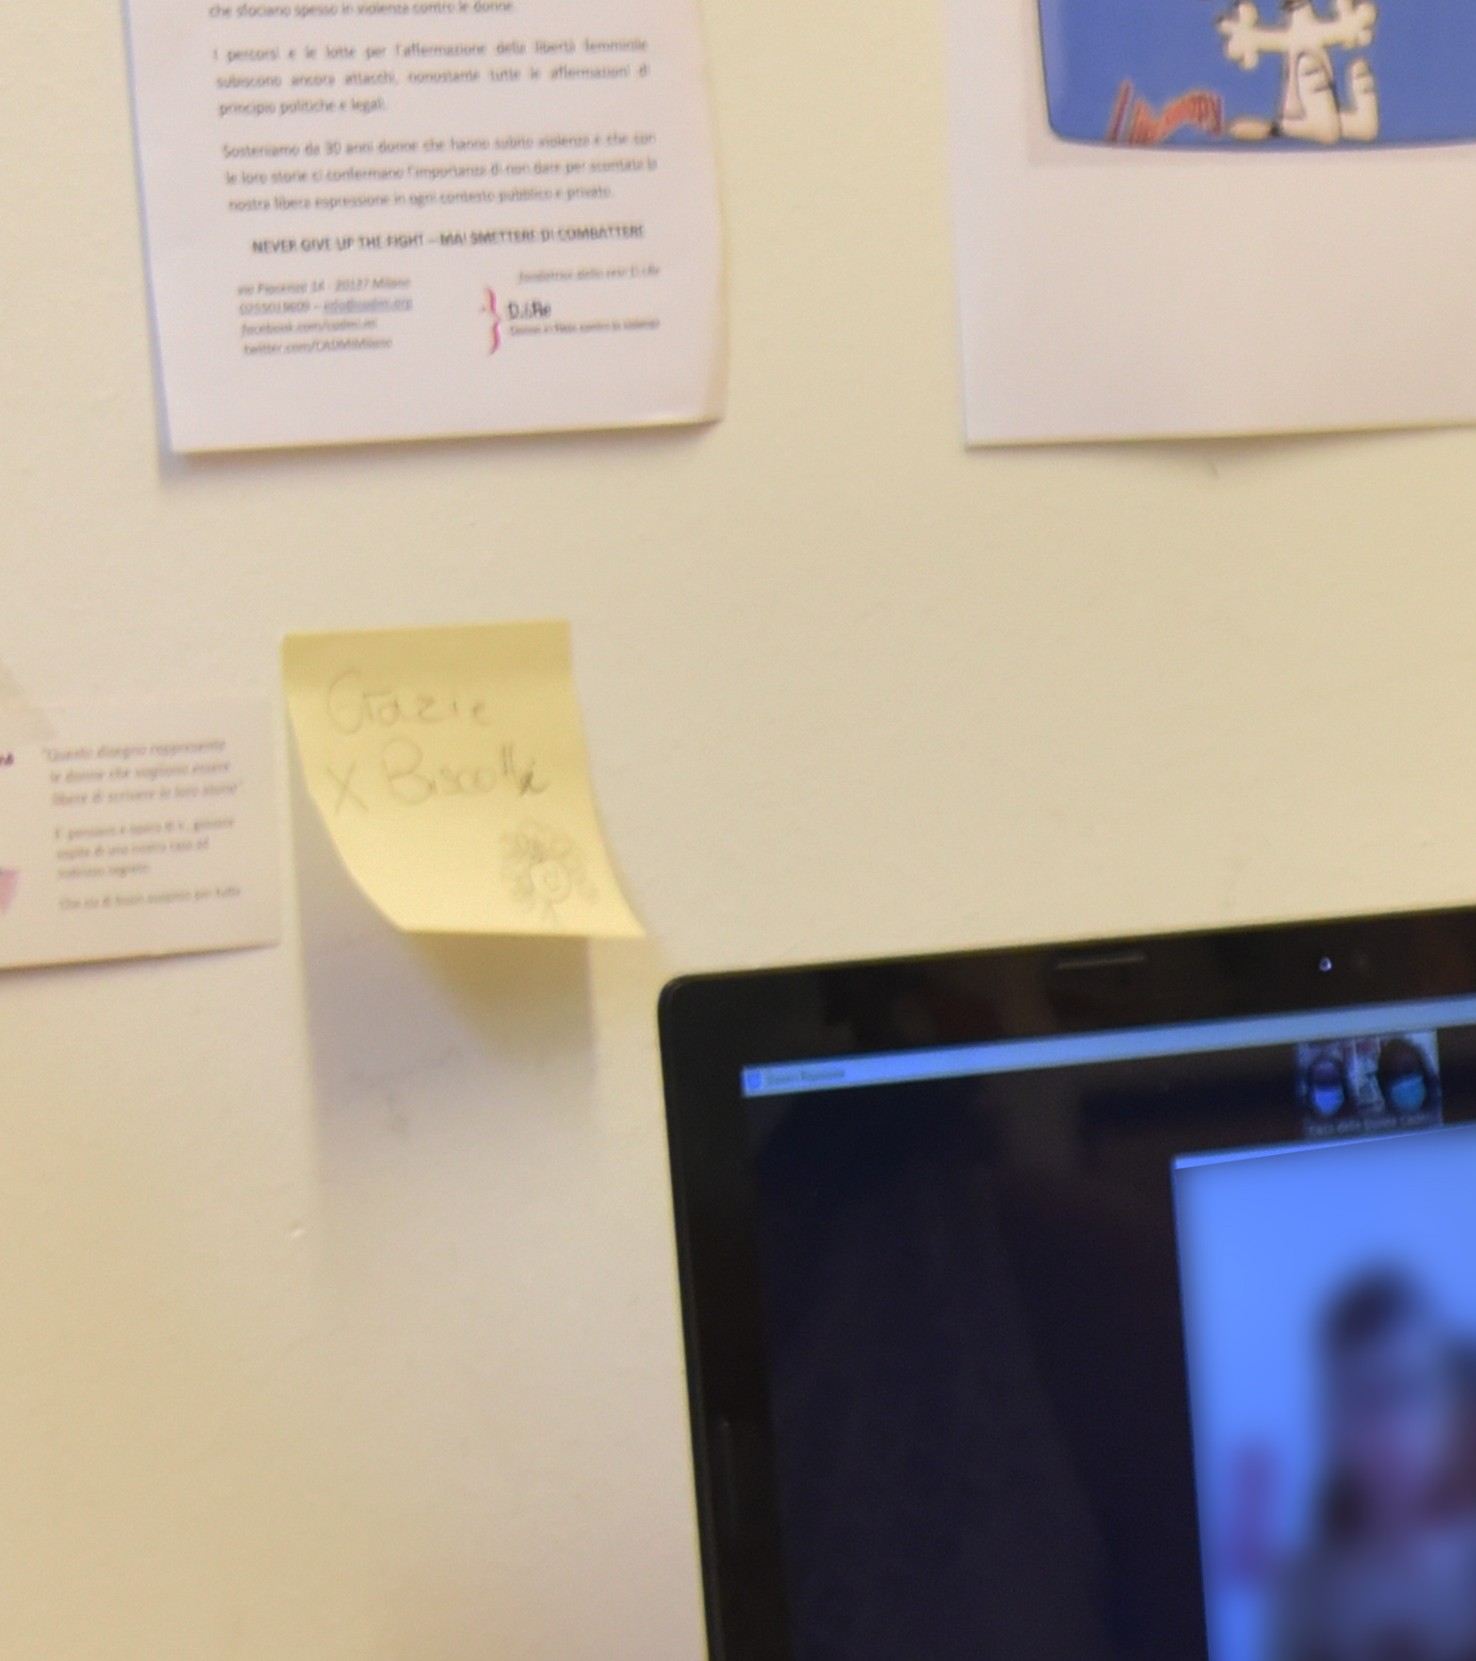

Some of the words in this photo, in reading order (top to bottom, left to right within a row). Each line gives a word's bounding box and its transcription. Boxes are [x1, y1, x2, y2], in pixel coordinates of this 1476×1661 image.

[295, 6, 337, 19] spesso
[366, 47, 386, 60] per
[291, 74, 335, 87] ancora
[218, 101, 277, 118] principio
[280, 98, 336, 115] politiche
[223, 144, 299, 158] Sosteniamo
[326, 141, 341, 156] 30
[346, 141, 373, 154] anni
[378, 140, 418, 154] donne
[451, 137, 489, 149] hanno
[326, 167, 404, 182] confermano
[252, 238, 297, 254] NEVER
[300, 237, 330, 252] GIVE
[335, 237, 353, 251] UP
[358, 235, 383, 250] THE
[387, 233, 424, 248] FIGHT
[439, 231, 467, 246] MAI
[471, 229, 537, 245] SMETTERE
[541, 227, 553, 242] DI
[557, 225, 643, 241] COMBATTERE
